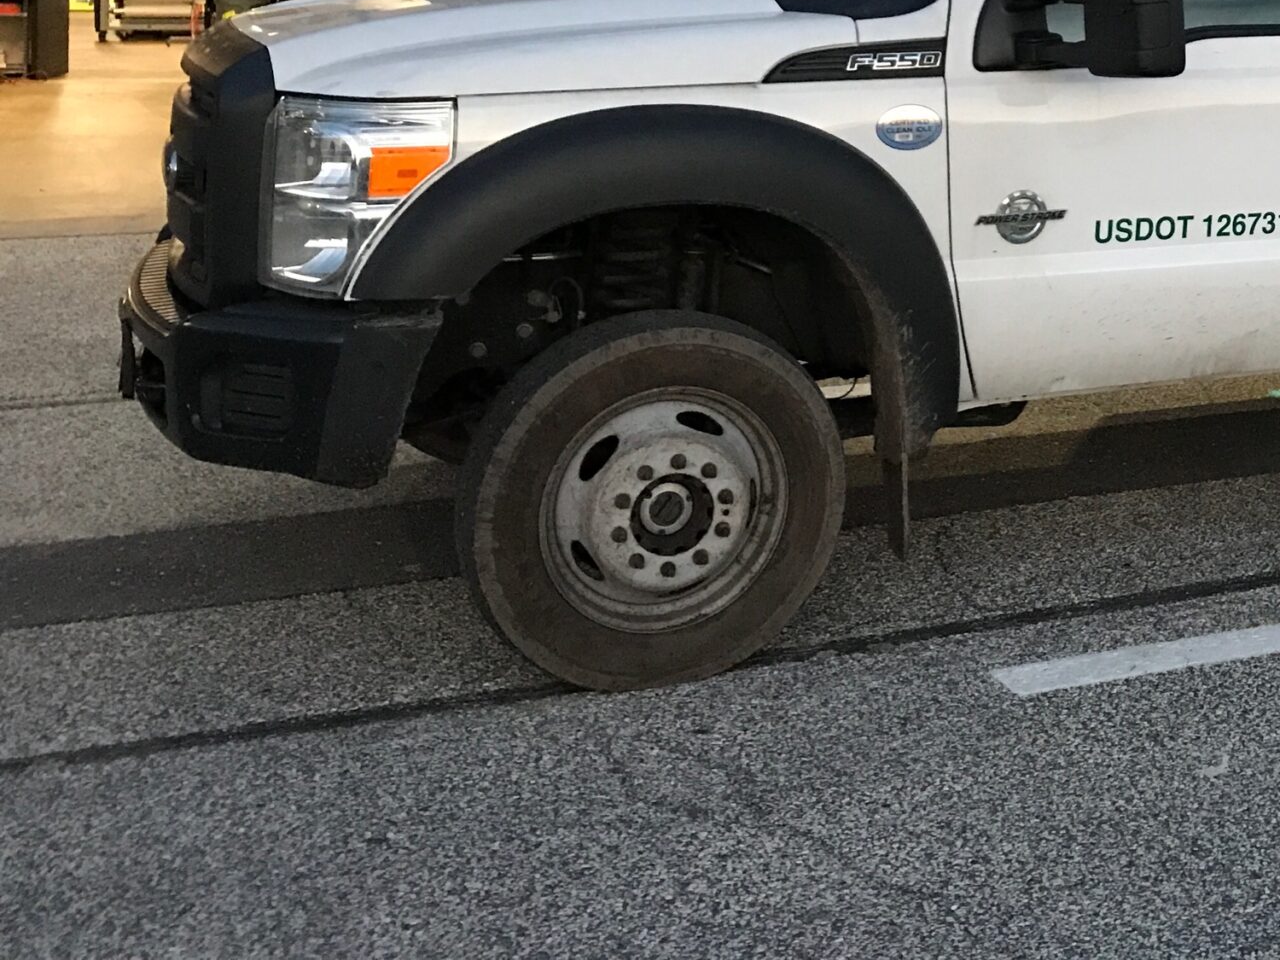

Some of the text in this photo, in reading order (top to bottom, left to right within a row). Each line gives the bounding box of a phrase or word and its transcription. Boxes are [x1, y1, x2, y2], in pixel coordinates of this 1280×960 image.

[846, 51, 942, 71] F-550
[974, 209, 1068, 226] POWER STROKE
[1094, 216, 1194, 244] USDOT
